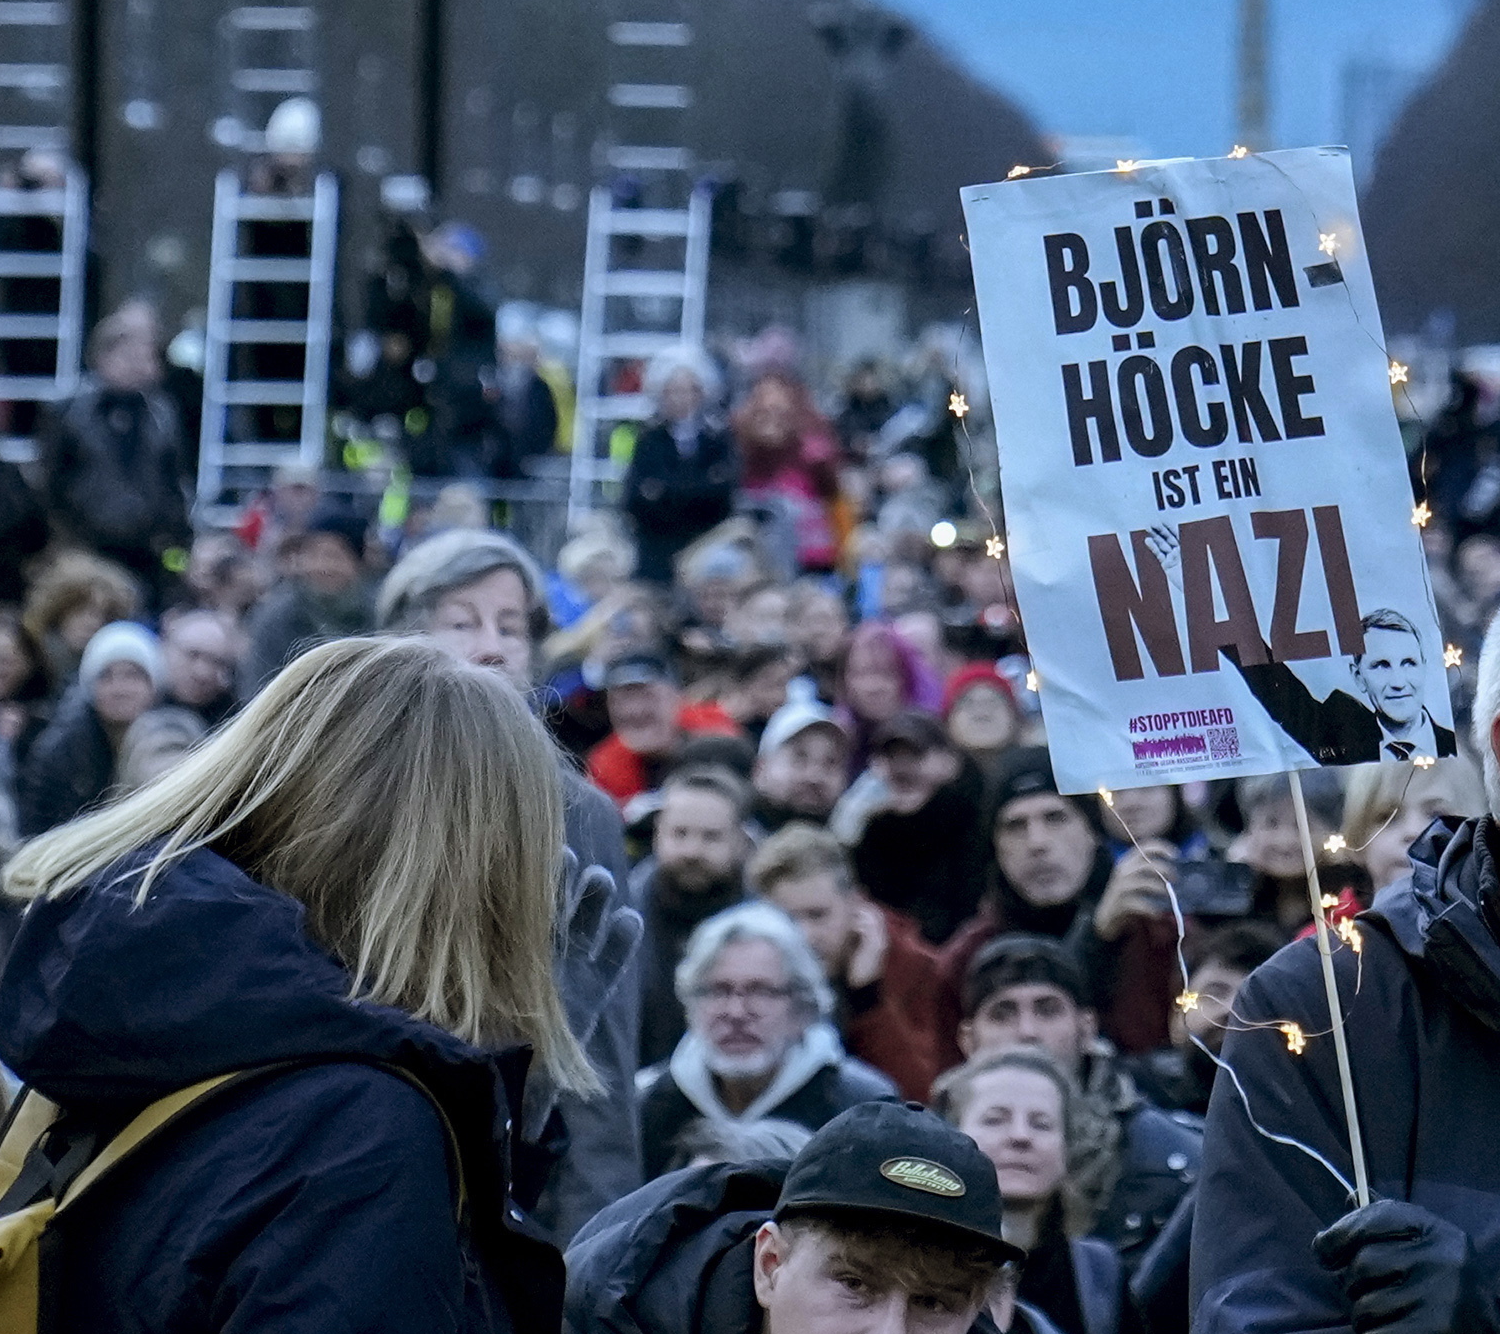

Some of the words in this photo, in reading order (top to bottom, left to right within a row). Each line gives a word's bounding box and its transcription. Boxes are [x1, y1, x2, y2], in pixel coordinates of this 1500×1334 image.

[1044, 198, 1344, 336] BJÖRN-
[1060, 331, 1326, 467] HÖCKE
[1151, 465, 1200, 511] IST
[1213, 457, 1261, 500] EIN
[1087, 505, 1367, 682] NAZI
[1128, 707, 1234, 734] #STOPPTDIEAFD
[890, 1161, 961, 1191] Billabong
